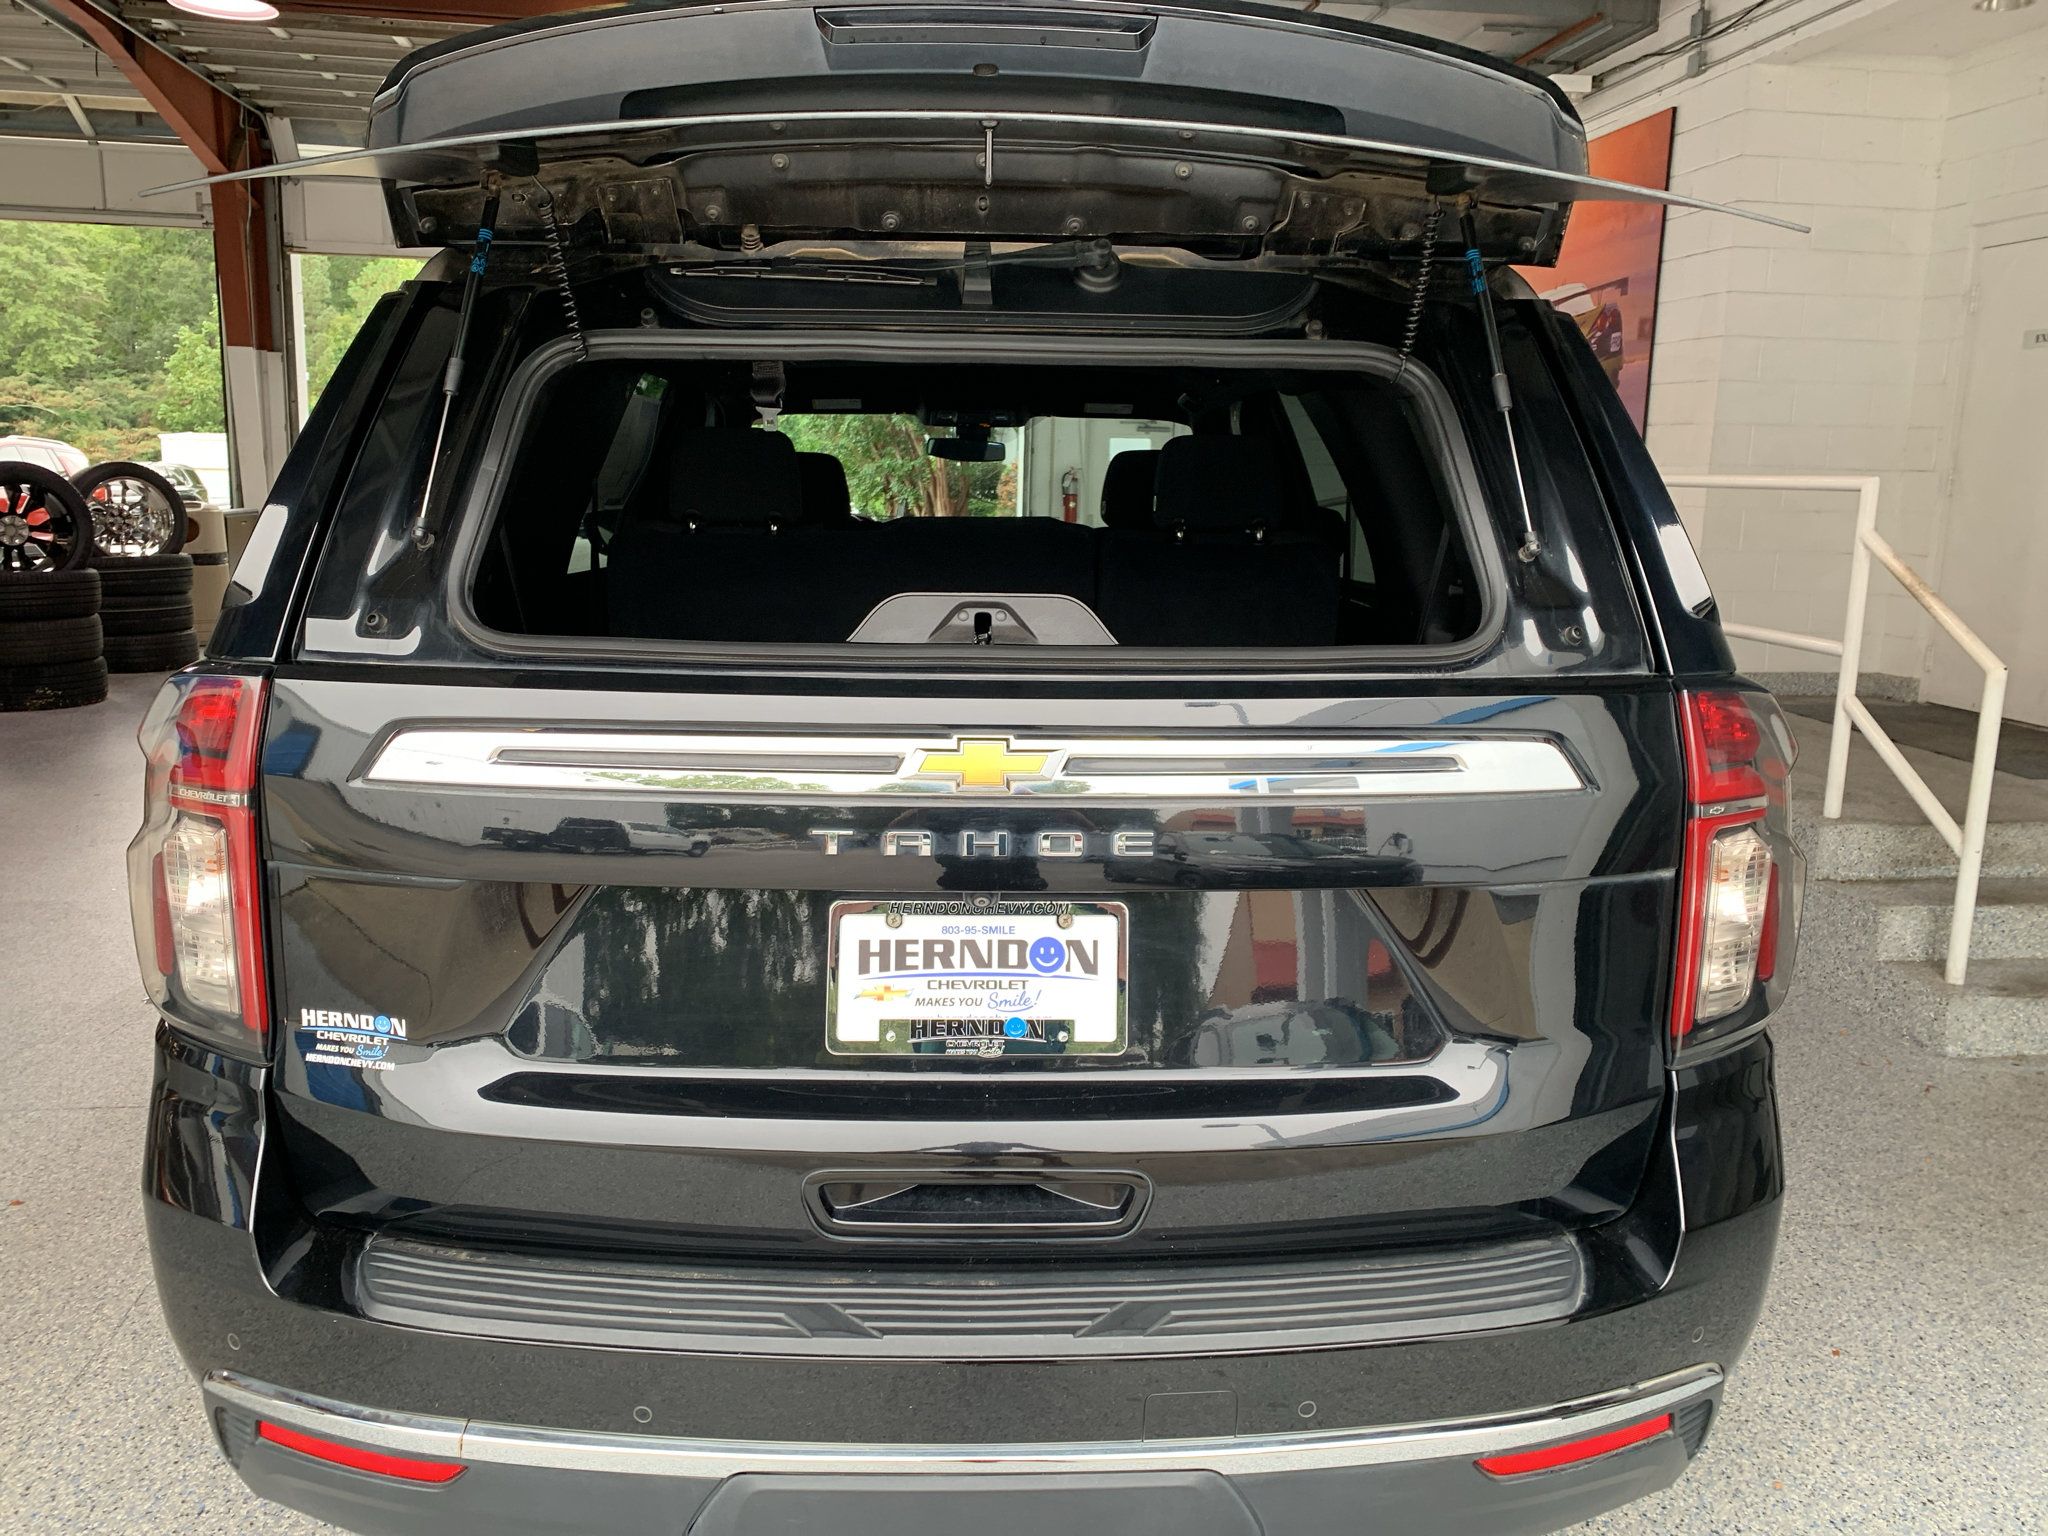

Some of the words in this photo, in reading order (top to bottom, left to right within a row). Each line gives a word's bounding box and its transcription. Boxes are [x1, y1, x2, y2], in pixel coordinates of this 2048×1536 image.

[179, 788, 228, 803] CHEVROLET
[808, 830, 1155, 857] TAHOE
[941, 925, 1016, 935] 803-95-SMILE
[858, 936, 1099, 976] HERNDON
[927, 979, 1029, 990] CHEVROLET
[914, 997, 955, 1007] MAKES
[957, 997, 984, 1007] YOU
[986, 989, 1043, 1012] Smile!
[301, 1008, 407, 1037] HERNDON
[316, 1031, 389, 1046] CHEVROLET
[315, 1043, 340, 1052] MAKES
[340, 1046, 356, 1054] YOU
[355, 1044, 390, 1060] Smile!
[305, 1052, 396, 1071] HERNDONCHEVY.COM
